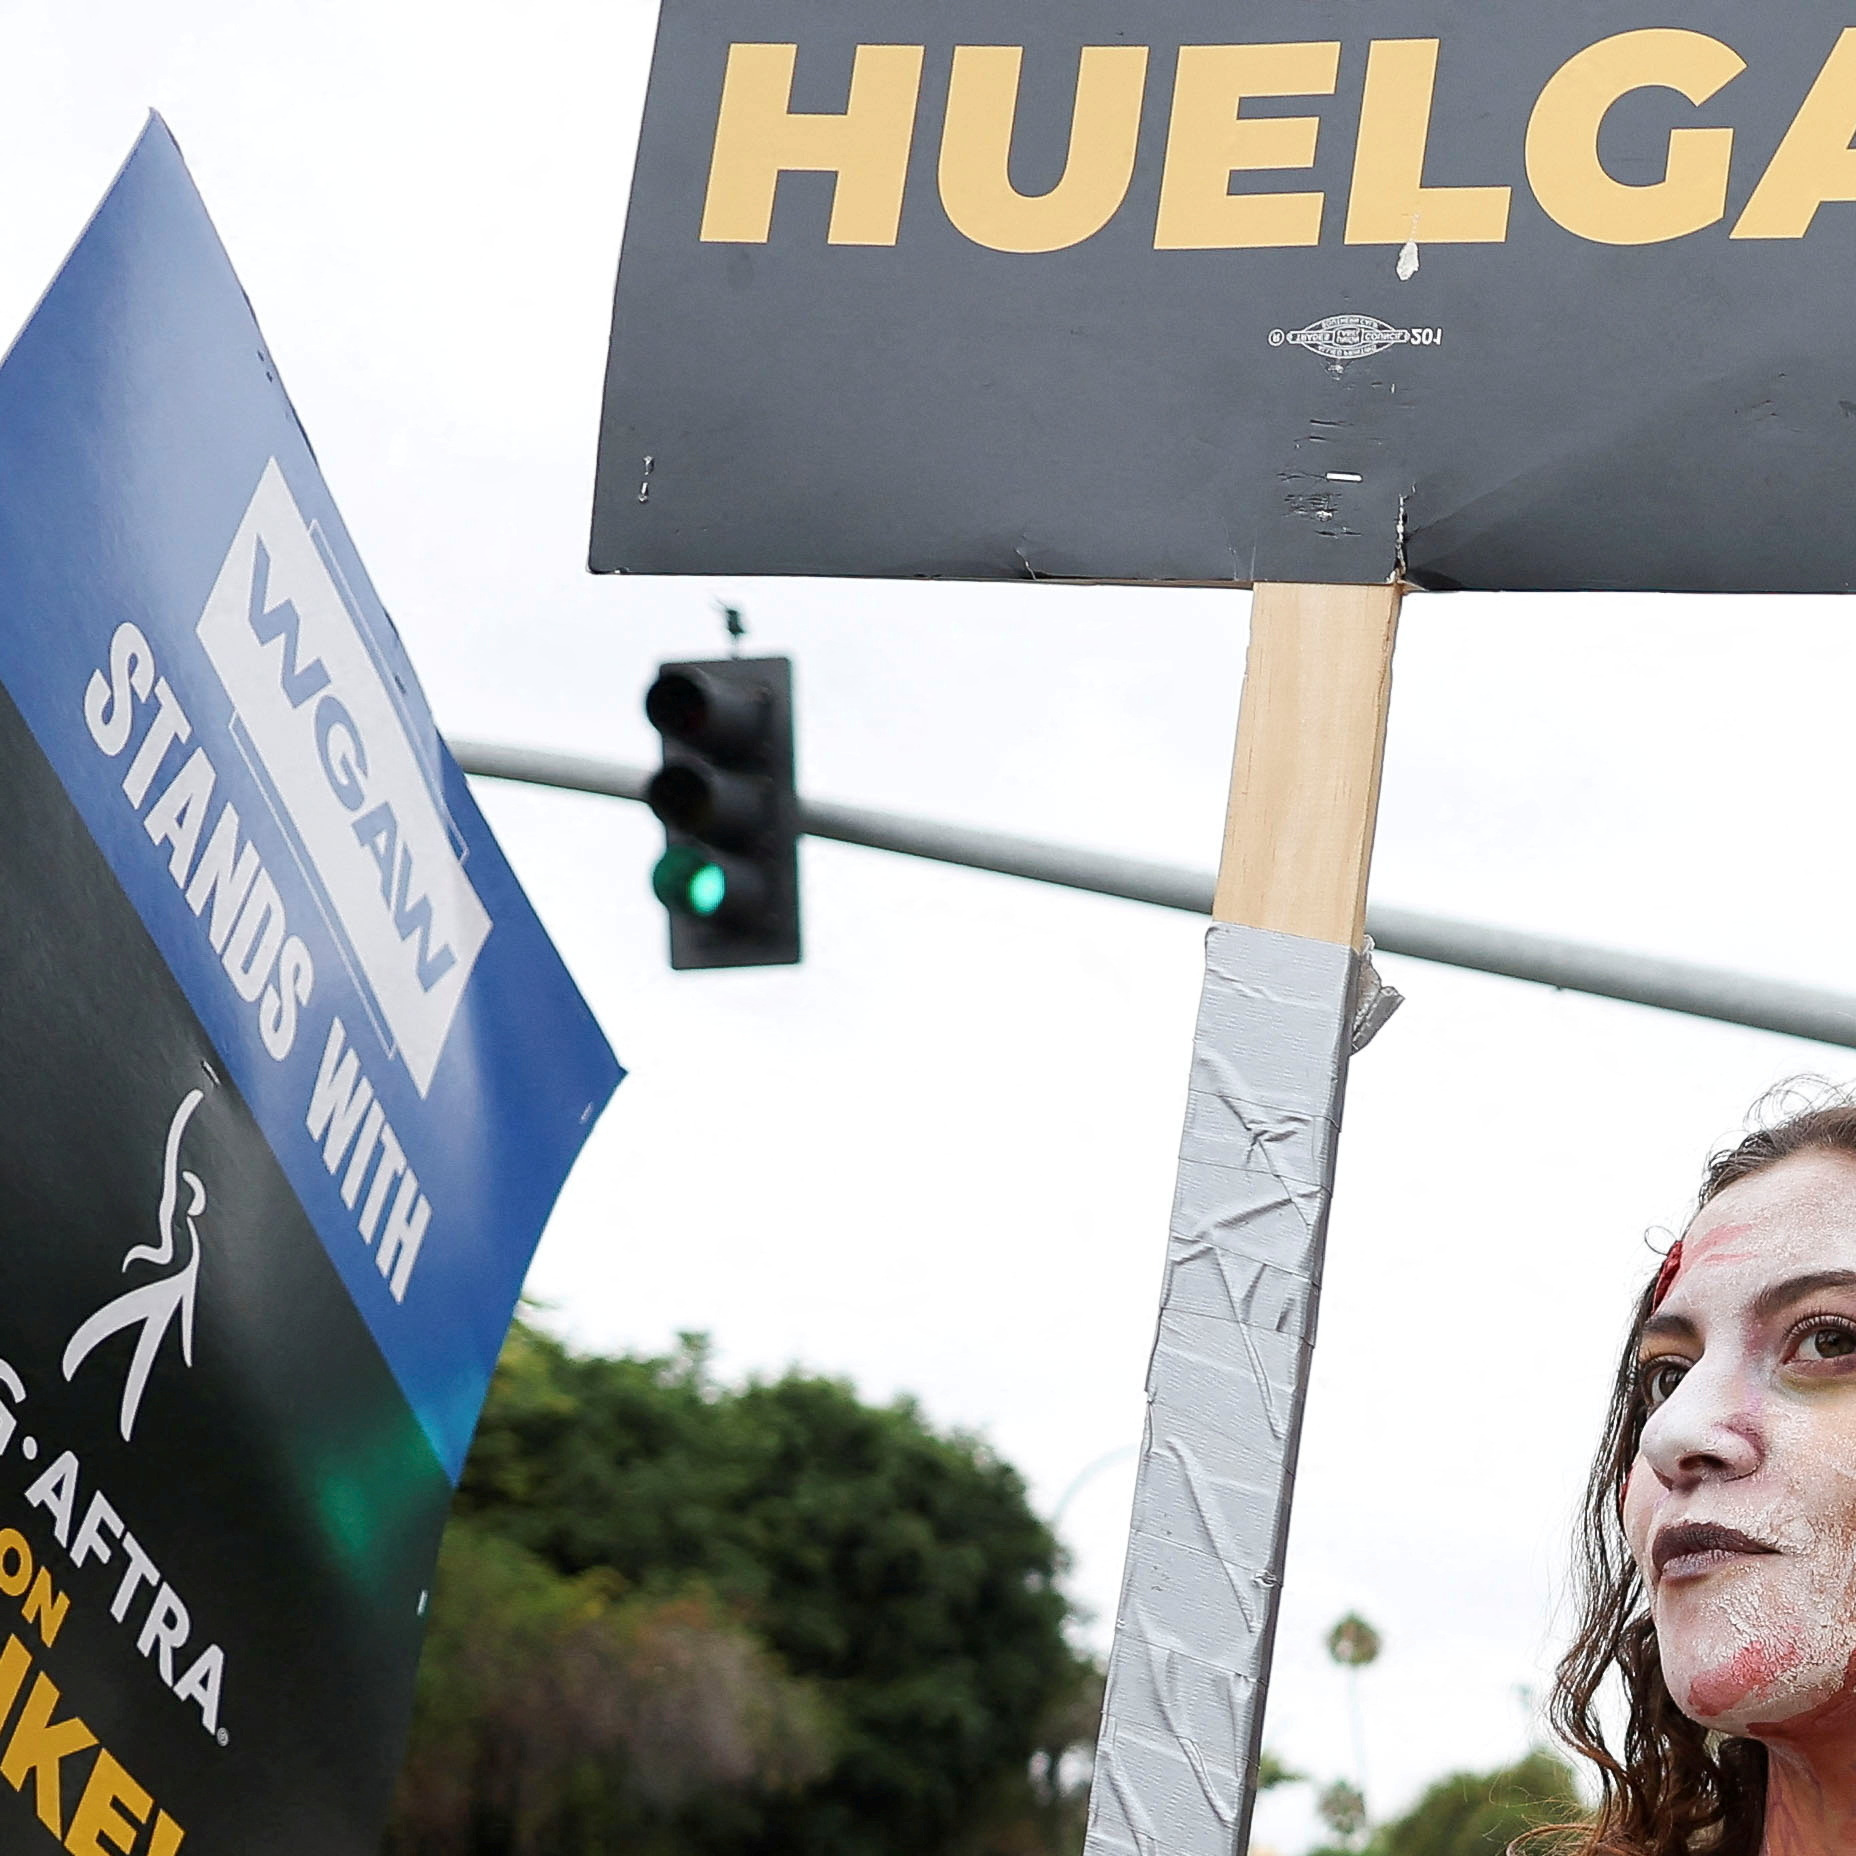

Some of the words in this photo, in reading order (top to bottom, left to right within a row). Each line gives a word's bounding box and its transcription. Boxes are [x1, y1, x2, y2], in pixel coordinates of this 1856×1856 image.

[84, 621, 314, 1062] STANDS
[305, 1016, 432, 1304] WITH
[249, 533, 457, 993] WGAW
[0, 1527, 70, 1648] ON
